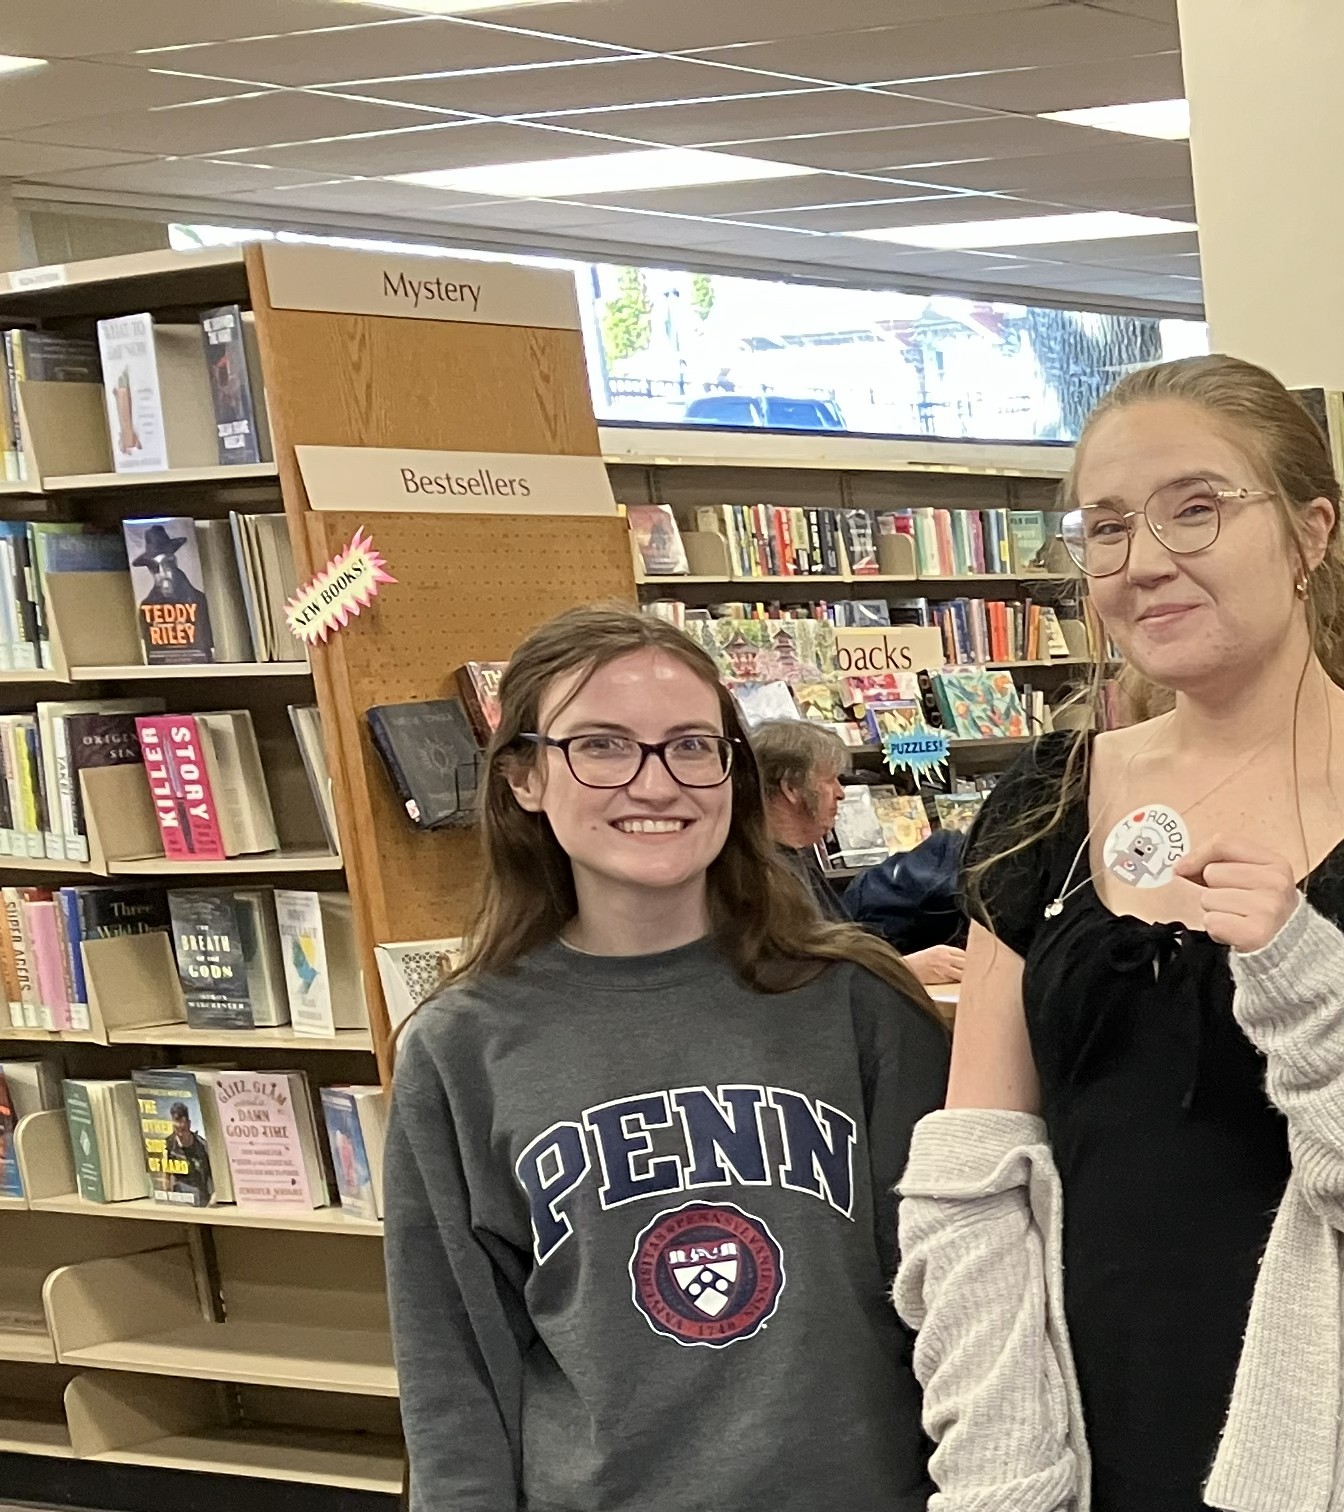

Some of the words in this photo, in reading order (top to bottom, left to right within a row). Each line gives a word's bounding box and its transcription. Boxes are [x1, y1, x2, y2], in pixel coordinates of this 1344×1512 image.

[384, 271, 481, 311] Mystery
[400, 467, 531, 498] Bestsellers
[320, 558, 366, 602] BOOKS!
[141, 603, 197, 623] TEDDY
[149, 623, 195, 645] RILEY
[891, 740, 944, 755] PUZZLES!
[141, 727, 179, 828] KILLER
[171, 726, 209, 820] STORY
[1146, 810, 1184, 861] ROBOTS
[181, 935, 230, 952] BREATH
[226, 1125, 259, 1138] GOOD
[515, 1084, 857, 1266] PENN
